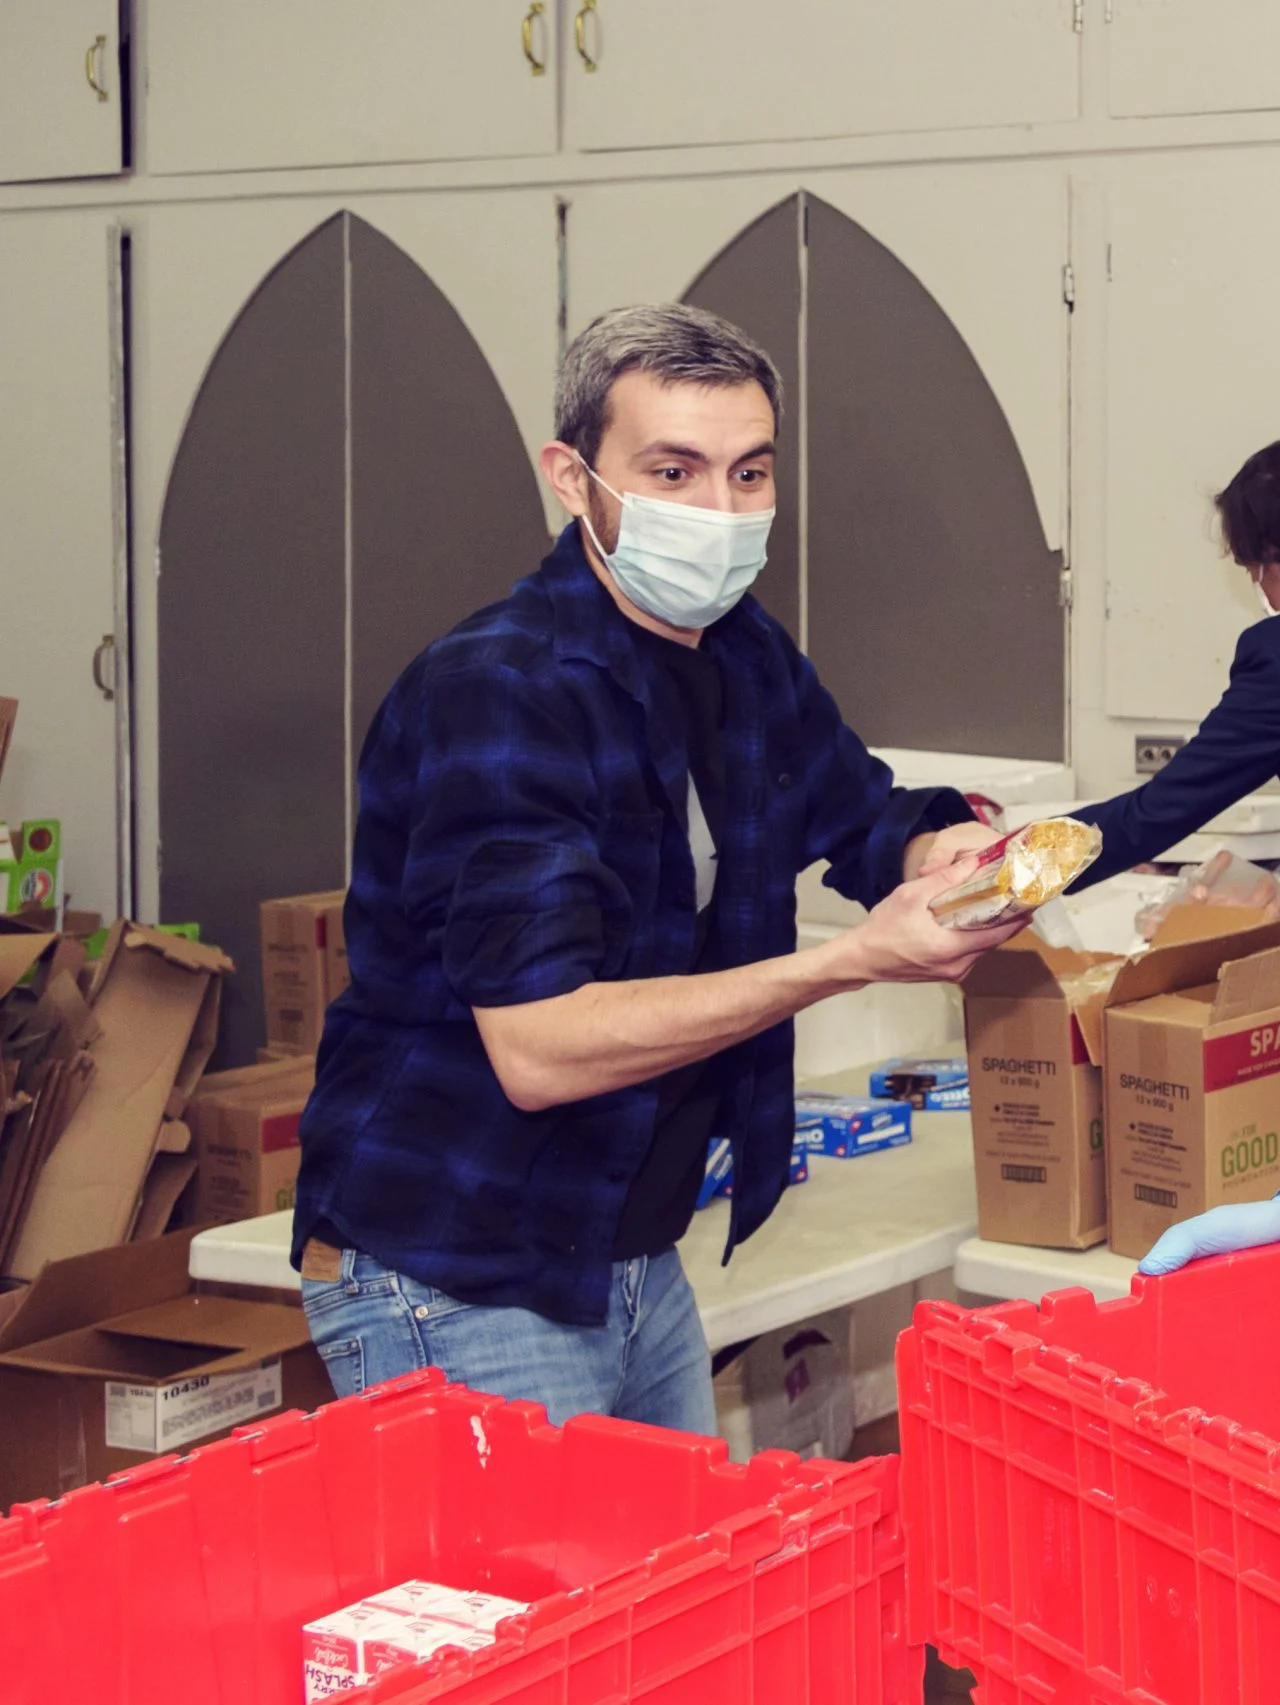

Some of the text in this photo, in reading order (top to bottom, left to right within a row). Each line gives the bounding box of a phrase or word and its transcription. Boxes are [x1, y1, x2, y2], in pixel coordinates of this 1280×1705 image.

[982, 1057, 1056, 1076] SPAGHETTI
[1120, 1073, 1189, 1101] SPAGHETTI
[1221, 1132, 1278, 1178] GOOD
[163, 1376, 210, 1400] 10430
[306, 1664, 355, 1688] SPLASH
